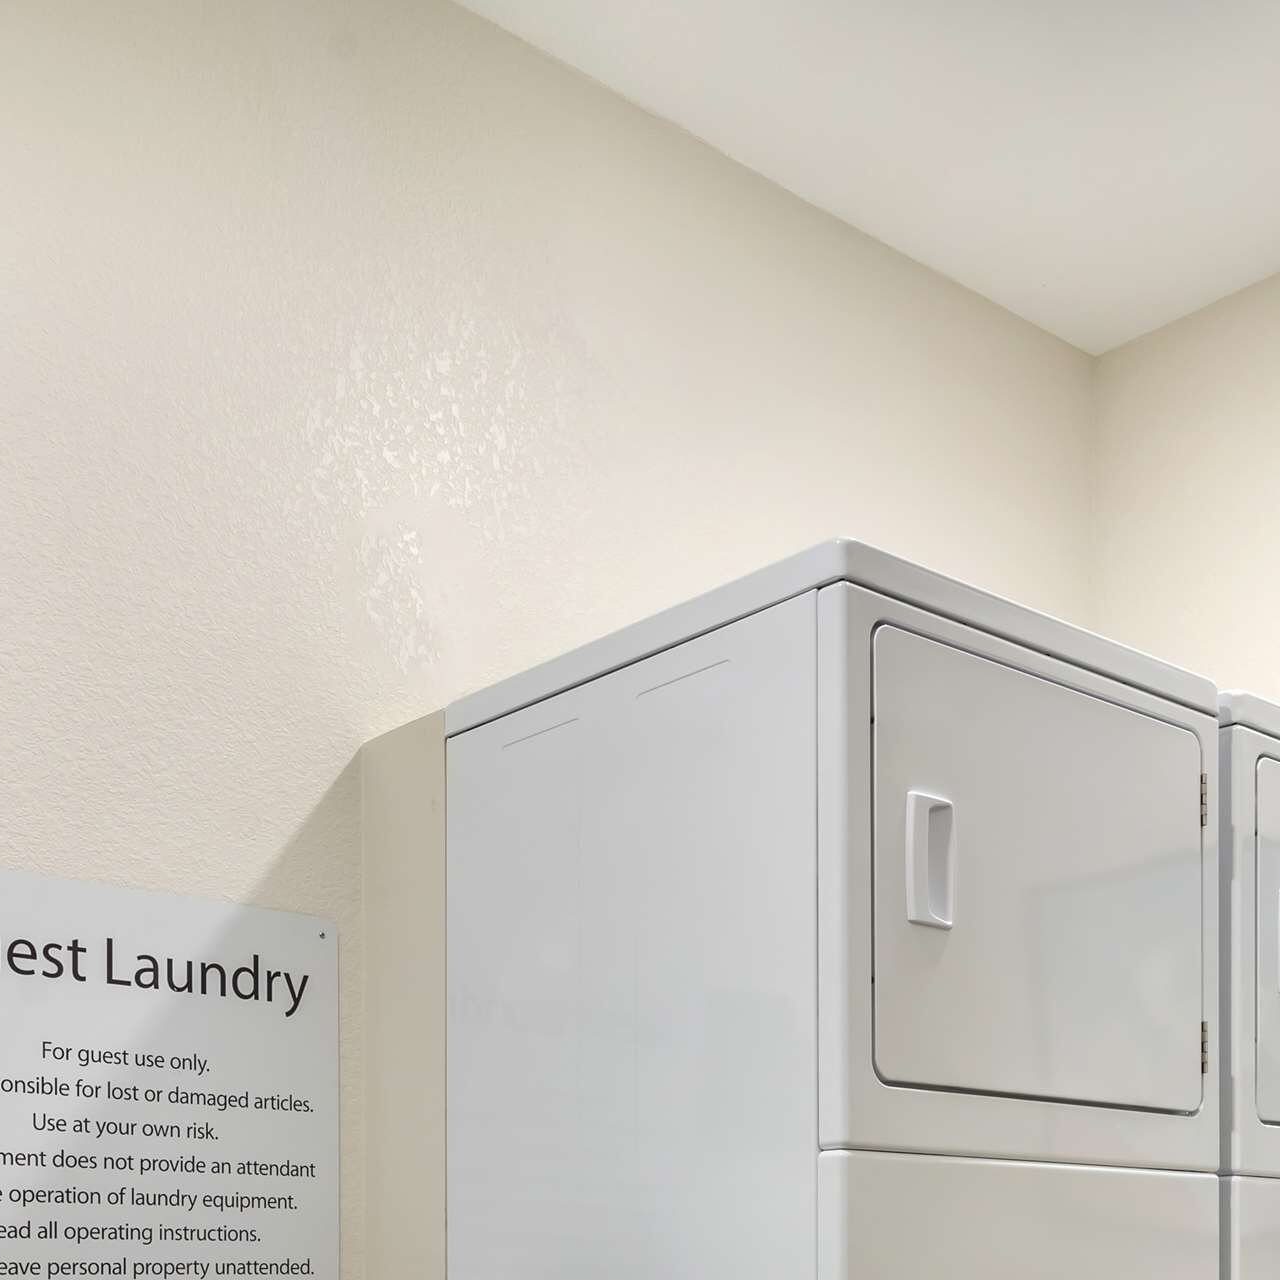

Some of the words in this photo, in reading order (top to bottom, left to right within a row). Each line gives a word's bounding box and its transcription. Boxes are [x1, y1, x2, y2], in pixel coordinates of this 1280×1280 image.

[106, 937, 310, 1018] Laundry
[42, 1041, 73, 1061] For
[77, 1048, 130, 1067] guest
[134, 1053, 166, 1069] use
[169, 1053, 210, 1077] only.
[74, 1078, 102, 1099] for
[107, 1080, 140, 1102] lost
[143, 1088, 164, 1103] or
[167, 1085, 249, 1112] damaged
[253, 1093, 314, 1113] articles.
[32, 1112, 68, 1133] Use
[72, 1117, 92, 1134] at
[95, 1120, 138, 1139] your
[141, 1123, 181, 1139] own
[186, 1121, 219, 1141] risk.
[52, 1148, 98, 1170] does
[103, 1155, 135, 1171] not
[139, 1154, 207, 1176] provide
[210, 1161, 232, 1175] an
[236, 1159, 316, 1178] attendant
[8, 1186, 102, 1208] operation
[106, 1186, 127, 1206] of
[131, 1187, 198, 1212] laundry
[202, 1191, 298, 1213] equipment.
[37, 1220, 58, 1240] all
[63, 1222, 153, 1246] operating
[159, 1223, 261, 1243] instructions.
[47, 1256, 127, 1280] personal
[132, 1260, 211, 1280] property
[215, 1257, 315, 1276] unattended.
